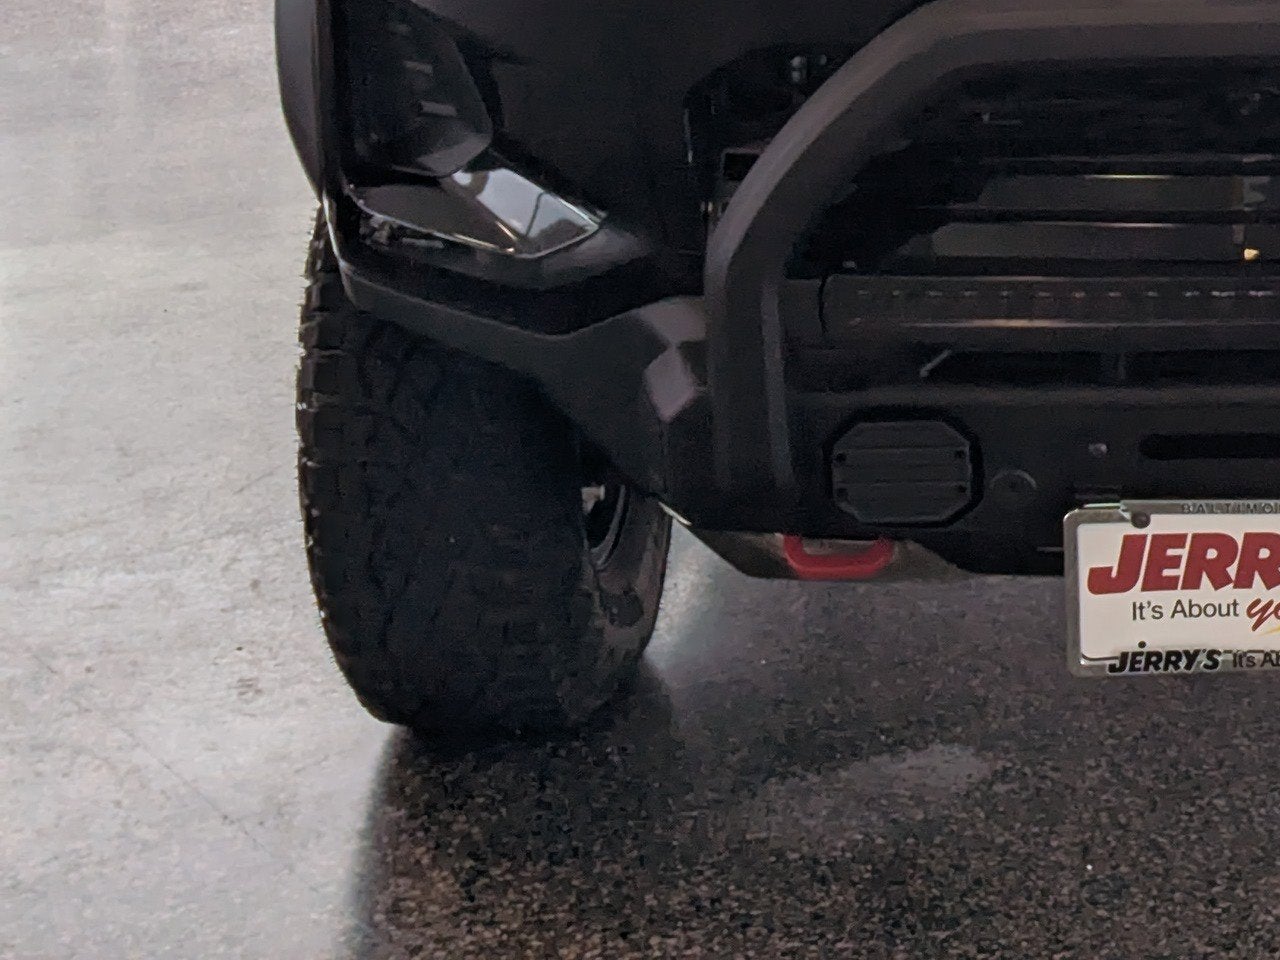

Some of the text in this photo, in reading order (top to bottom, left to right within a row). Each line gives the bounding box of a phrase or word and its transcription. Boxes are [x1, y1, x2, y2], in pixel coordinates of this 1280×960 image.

[1131, 601, 1164, 621] It's
[1170, 599, 1240, 619] About
[1107, 648, 1222, 674] JERRY'S
[1231, 652, 1257, 668] It's
